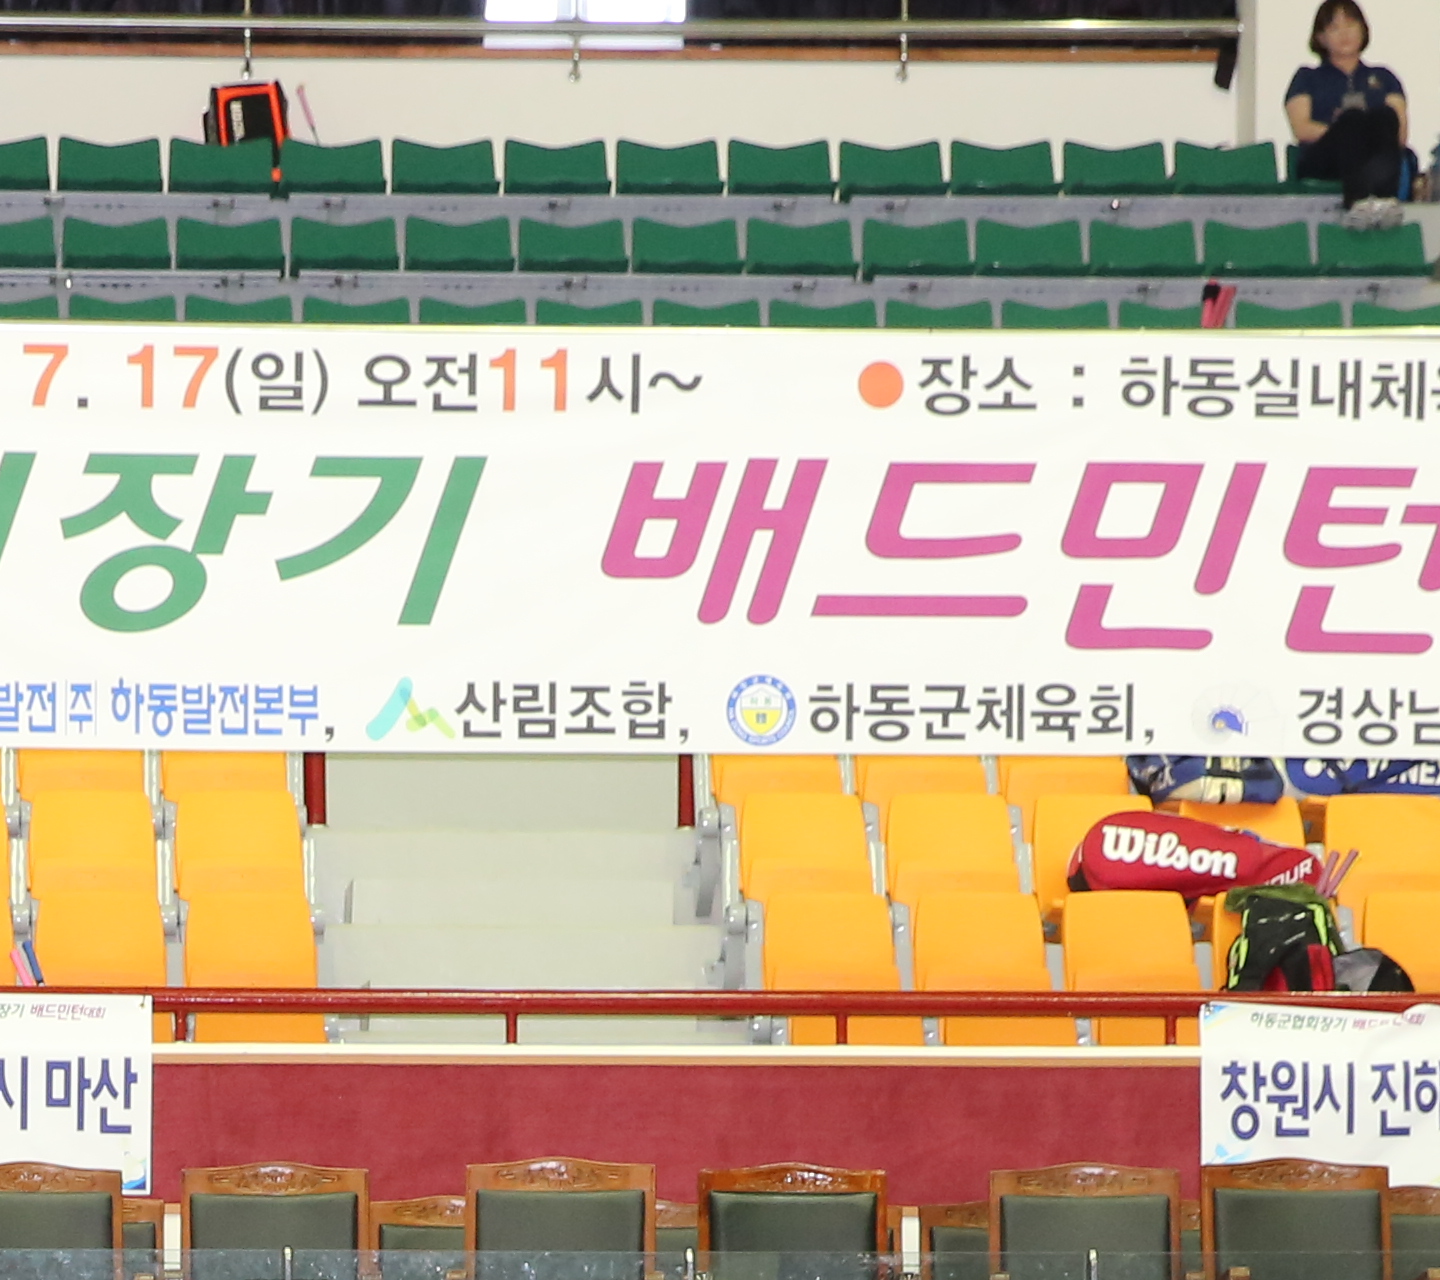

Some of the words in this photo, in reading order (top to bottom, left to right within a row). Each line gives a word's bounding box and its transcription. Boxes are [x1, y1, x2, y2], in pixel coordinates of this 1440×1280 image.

[24, 345, 88, 408] 7.
[128, 345, 328, 415] 17(일)
[358, 349, 702, 414] 오전11시~
[919, 356, 1036, 416] 장소
[112, 679, 334, 741] 하동발전본부,
[456, 682, 688, 743] 산림조합,
[809, 684, 1153, 743] 하동군체육회,
[1102, 824, 1238, 879] Wilson
[29, 1003, 107, 1021] 배드민턴대회
[46, 1057, 138, 1134] 마산
[1221, 1061, 1354, 1141] 창원시
